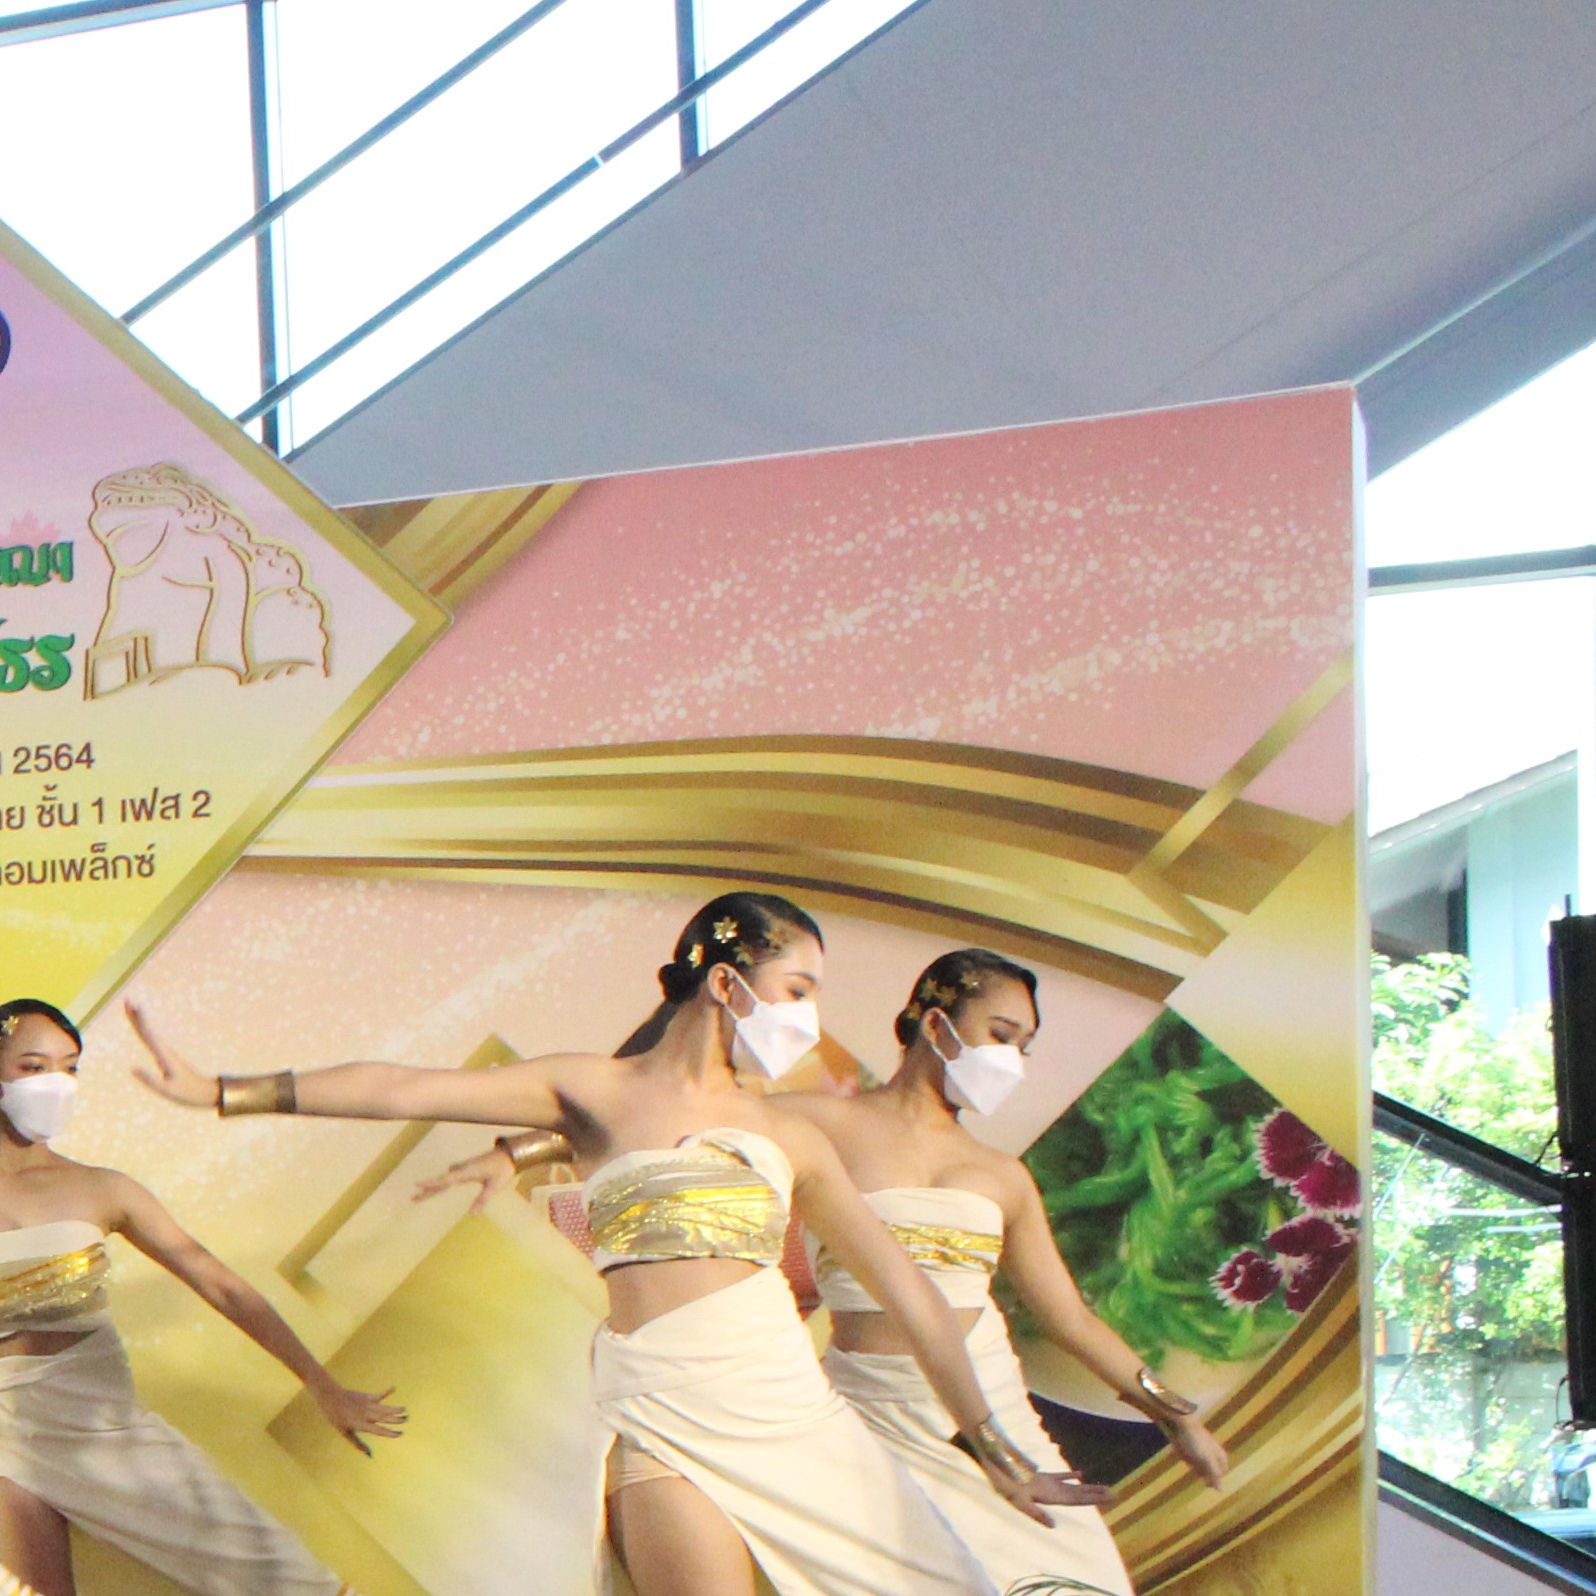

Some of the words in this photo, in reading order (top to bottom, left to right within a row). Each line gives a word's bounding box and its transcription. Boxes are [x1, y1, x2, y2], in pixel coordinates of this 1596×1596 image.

[12, 741, 95, 774] 2564
[37, 784, 79, 829] ชั้น
[90, 798, 105, 823] 1
[121, 787, 181, 823] เฟส
[192, 790, 212, 818] 2
